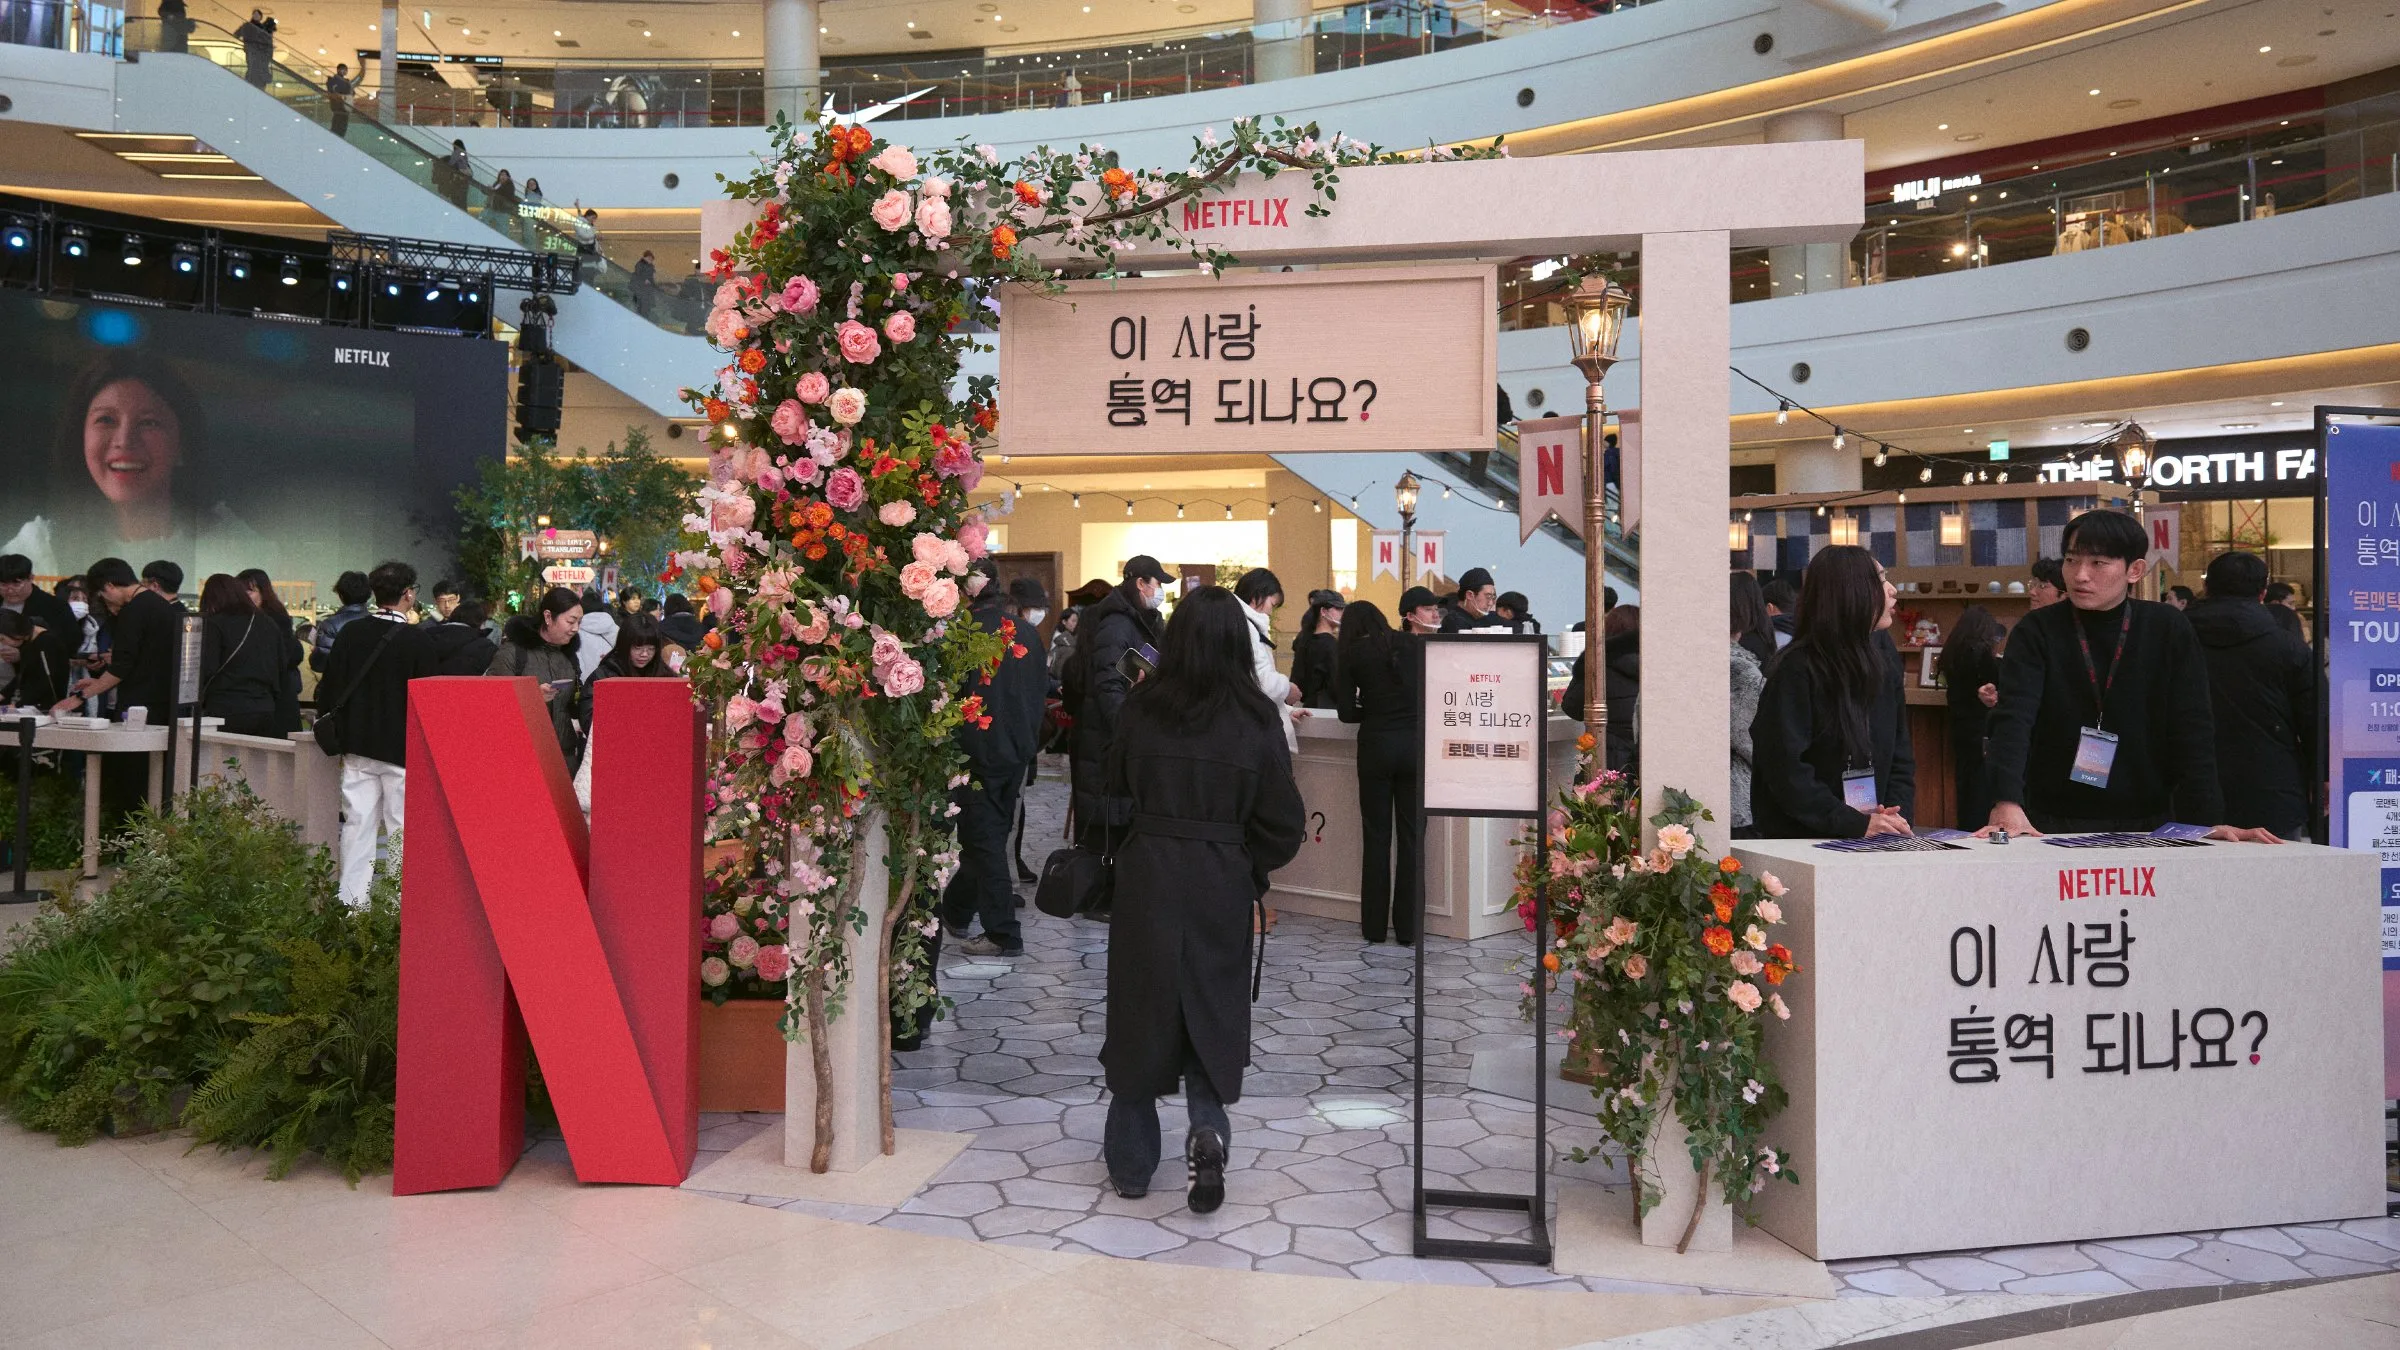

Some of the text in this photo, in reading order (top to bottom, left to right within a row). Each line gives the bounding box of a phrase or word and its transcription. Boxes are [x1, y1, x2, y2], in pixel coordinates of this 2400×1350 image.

[1894, 177, 1940, 203] MUJI
[1184, 199, 1288, 231] NETFLIX
[1111, 304, 1261, 361] 이 사랑
[335, 347, 390, 367] NETFLIX
[1107, 372, 1377, 426] 통역 되나요?
[1537, 444, 1564, 496] N
[2042, 449, 2327, 487] THE ORTH FA
[2358, 500, 2377, 527] 이
[2153, 519, 2169, 550] N
[1380, 542, 1392, 563] N
[1424, 542, 1436, 564] N
[552, 571, 586, 580] NETFLIX
[2349, 621, 2400, 643] TOU
[1470, 675, 1501, 683] NETFLIX
[1444, 689, 1494, 707] 이 사랑
[1444, 709, 1532, 727] 통역 되나요?
[1449, 743, 1520, 759] 로맨틱 트립
[2385, 768, 2400, 785] 패
[2386, 811, 2400, 822] 4개
[2384, 825, 2400, 835] 스탬
[2059, 866, 2156, 901] NETFLIX
[1951, 909, 2136, 988] 이 사랑
[1948, 1005, 2268, 1083] 통역 되나요?
